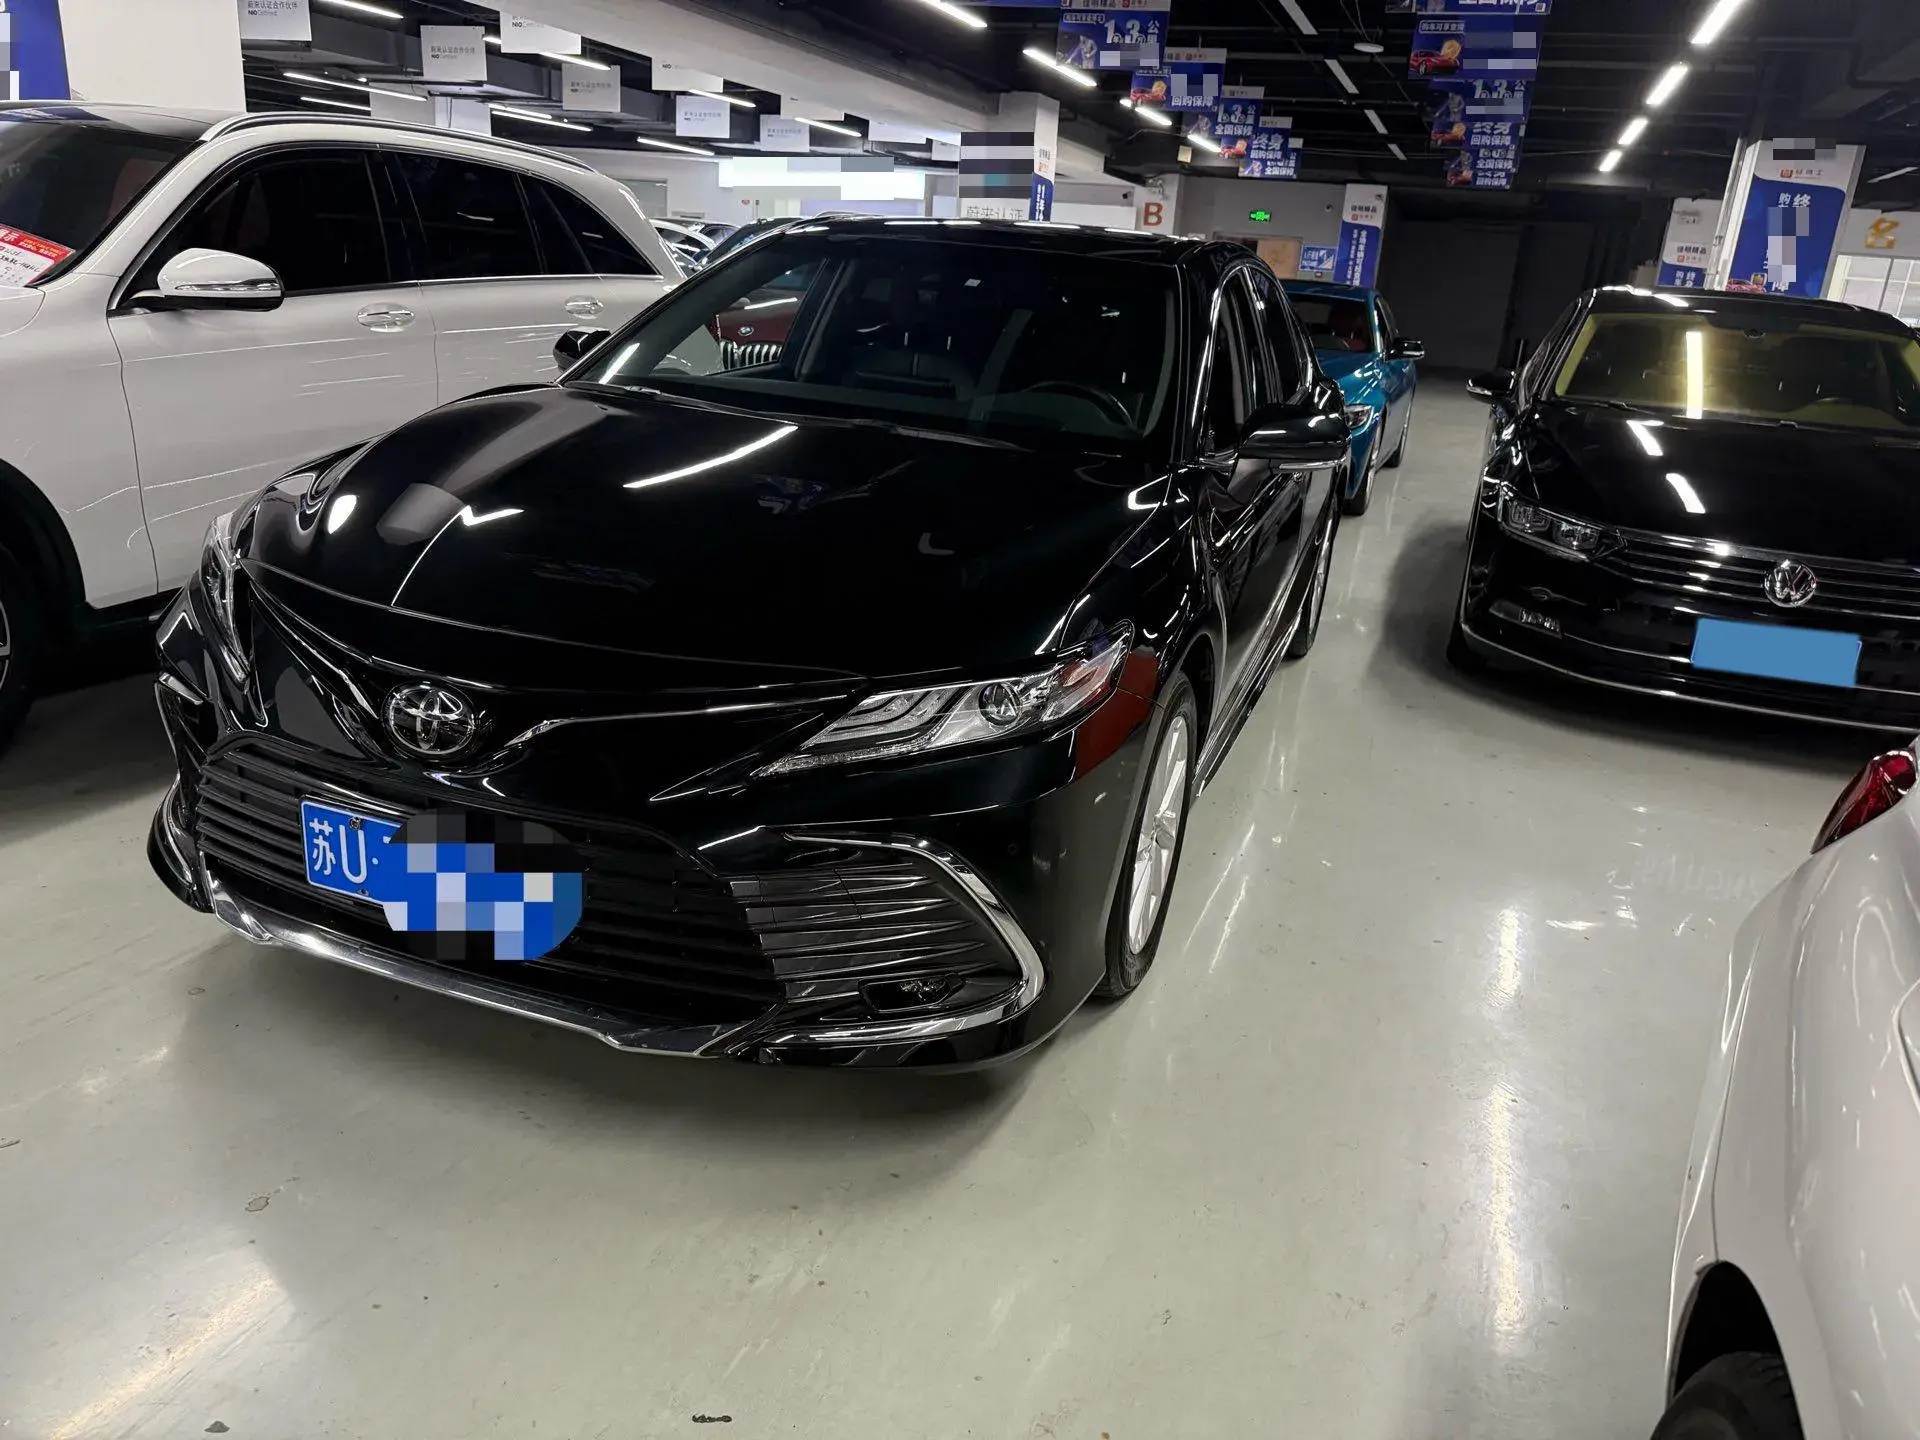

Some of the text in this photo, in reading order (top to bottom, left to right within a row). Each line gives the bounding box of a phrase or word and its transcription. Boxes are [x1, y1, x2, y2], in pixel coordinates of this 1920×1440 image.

[1171, 95, 1214, 107] 回购保障
[1214, 124, 1254, 136] 全国保修
[1252, 133, 1284, 150] 终身
[1470, 134, 1512, 146] 回购保障
[1143, 202, 1163, 226] B
